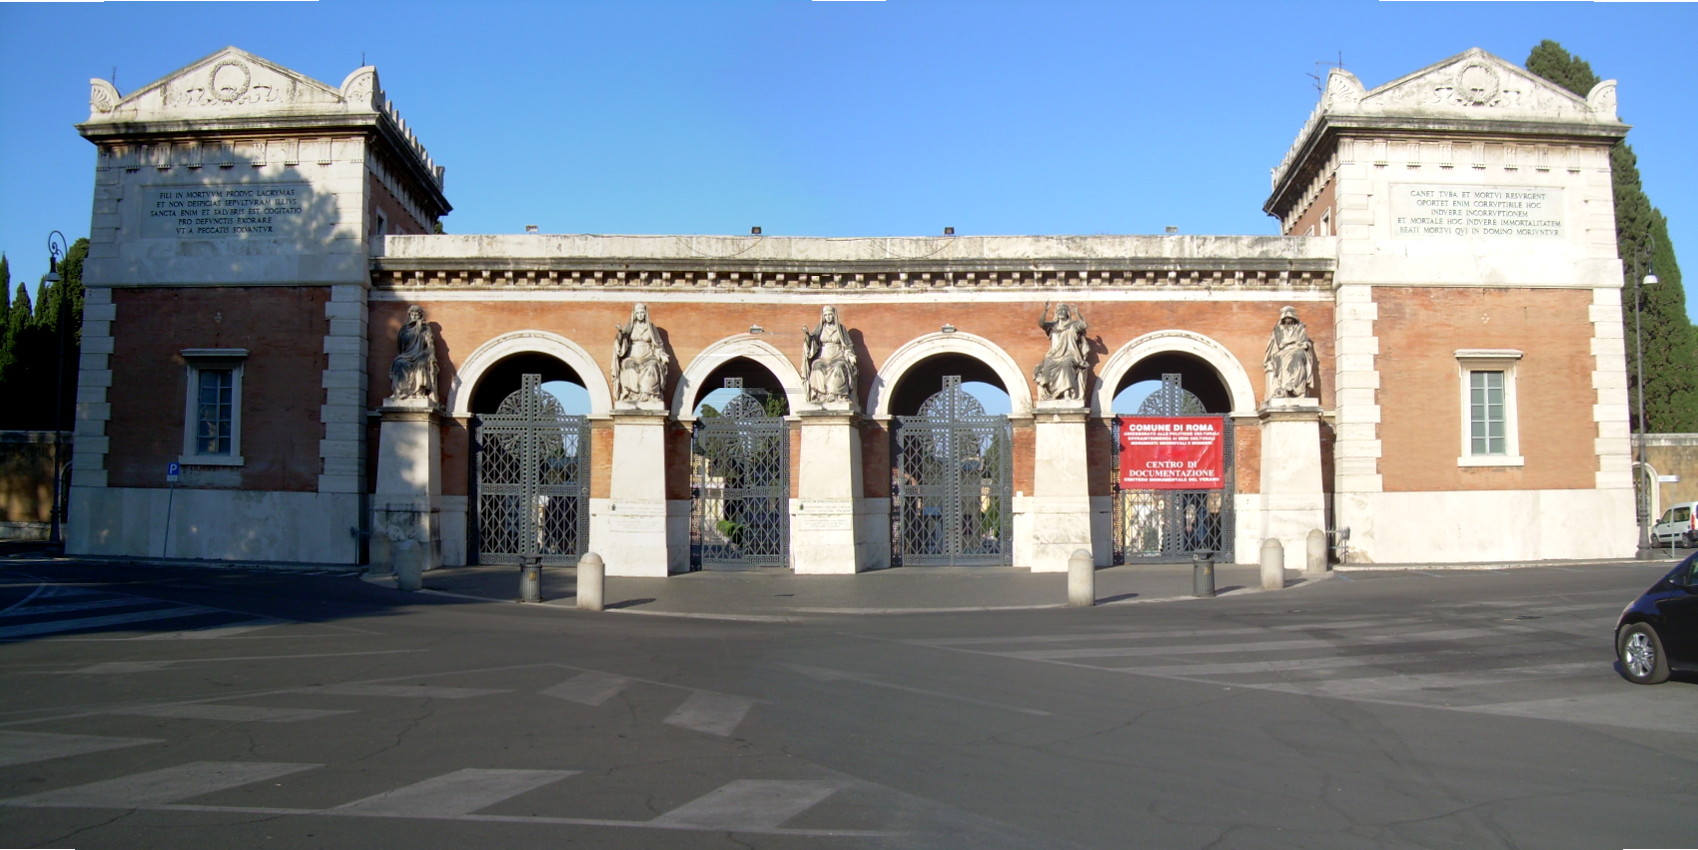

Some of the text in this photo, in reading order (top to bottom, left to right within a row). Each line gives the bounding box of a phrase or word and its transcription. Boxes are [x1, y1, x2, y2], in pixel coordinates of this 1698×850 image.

[238, 216, 272, 224] EXORARE
[1455, 228, 1468, 236] QVI
[170, 464, 178, 474] P
